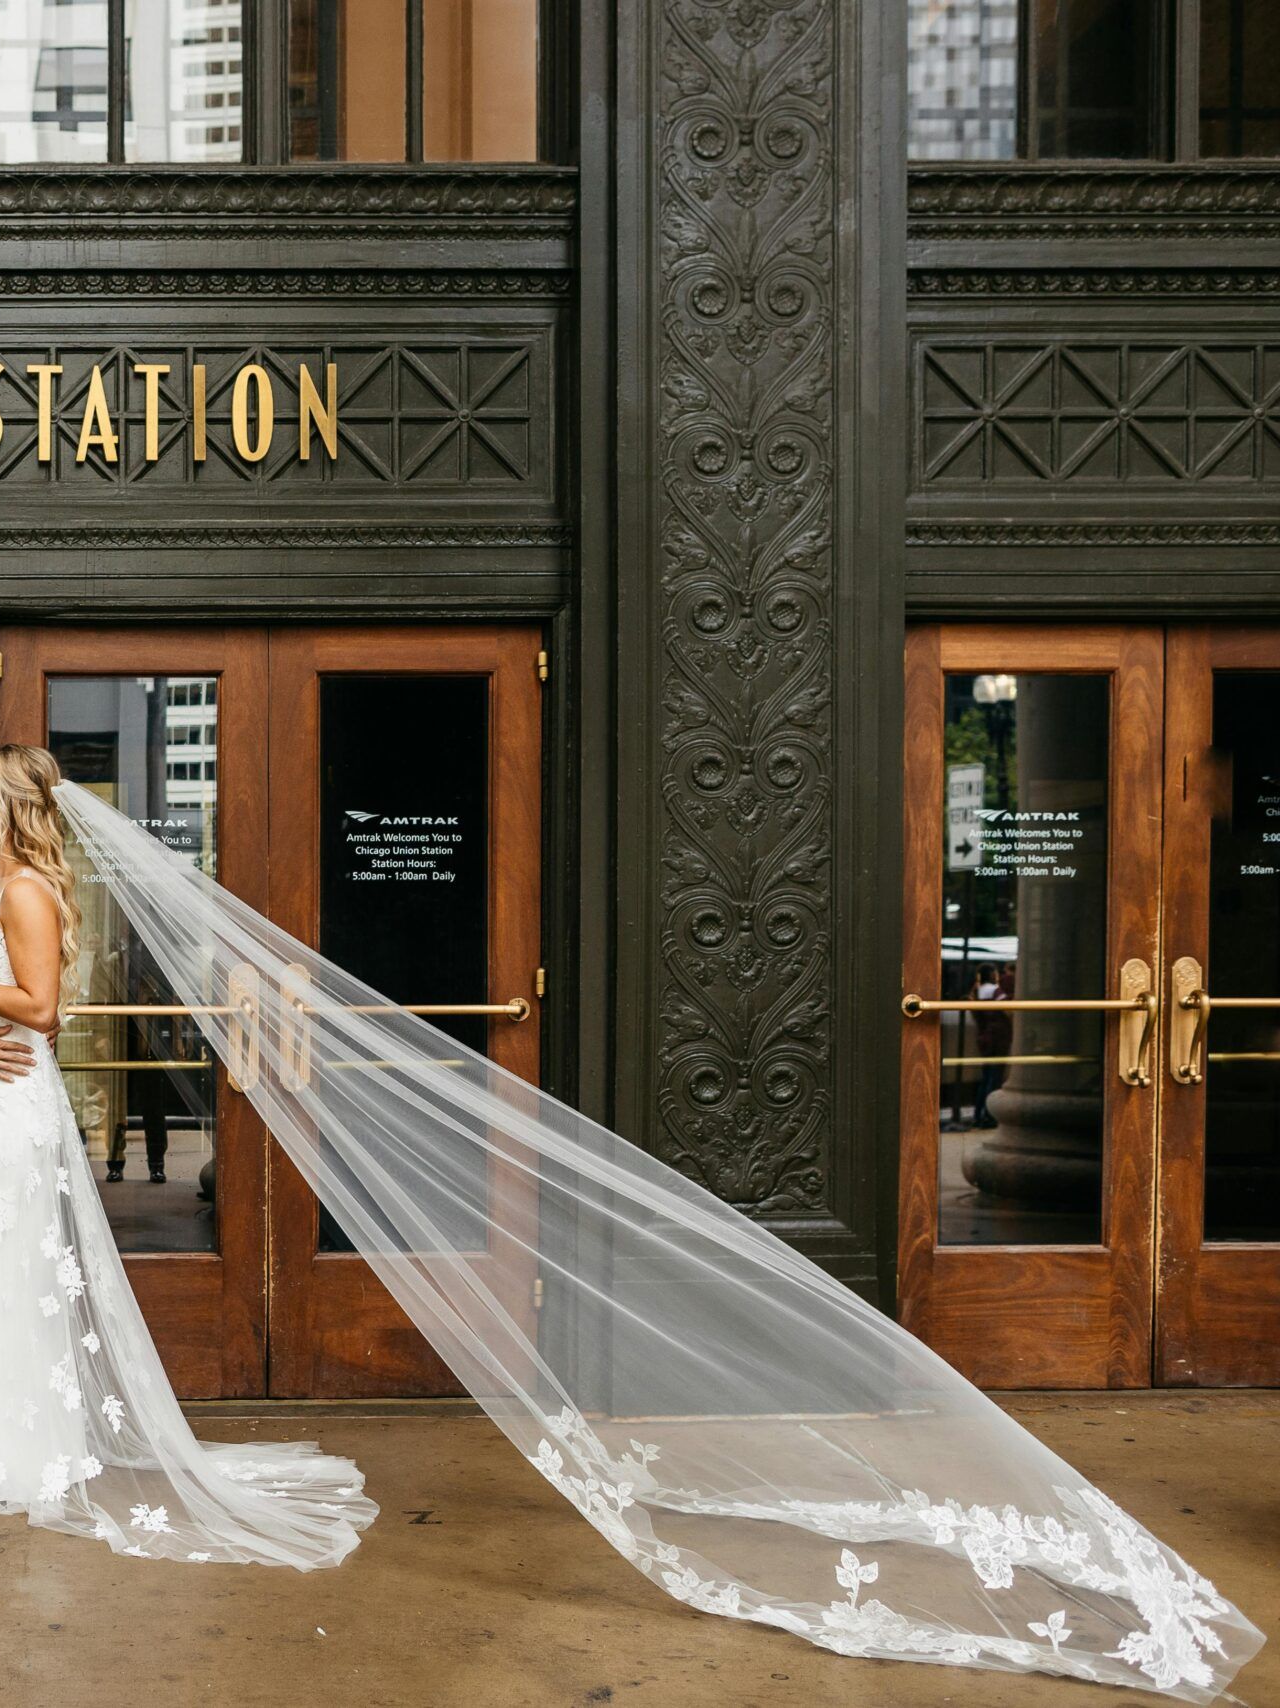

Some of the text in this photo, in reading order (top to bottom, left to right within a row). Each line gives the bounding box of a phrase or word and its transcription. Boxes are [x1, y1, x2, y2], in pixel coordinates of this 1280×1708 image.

[380, 817, 458, 825] AMTRAK
[1002, 812, 1080, 821] AMTRAK
[346, 833, 381, 842] Amtrak
[383, 833, 430, 842] Welcomes
[431, 833, 450, 842] You
[968, 829, 1083, 838] Amtrak Welcomes You to
[1262, 833, 1280, 842] 5:00
[161, 836, 179, 844] You
[355, 846, 453, 857] Chicago Union Station
[977, 842, 1074, 853] Chicago Union Station
[993, 854, 1058, 863] Station Hours:
[371, 859, 437, 868] Station Hours:
[974, 867, 1007, 876] 5:00am
[1016, 867, 1048, 876] 1:00am
[1053, 867, 1076, 878] Daily
[1240, 865, 1274, 875] 5:00am
[352, 871, 386, 880] 5:00am
[395, 871, 428, 880] 1:00am
[432, 871, 456, 882] Daily
